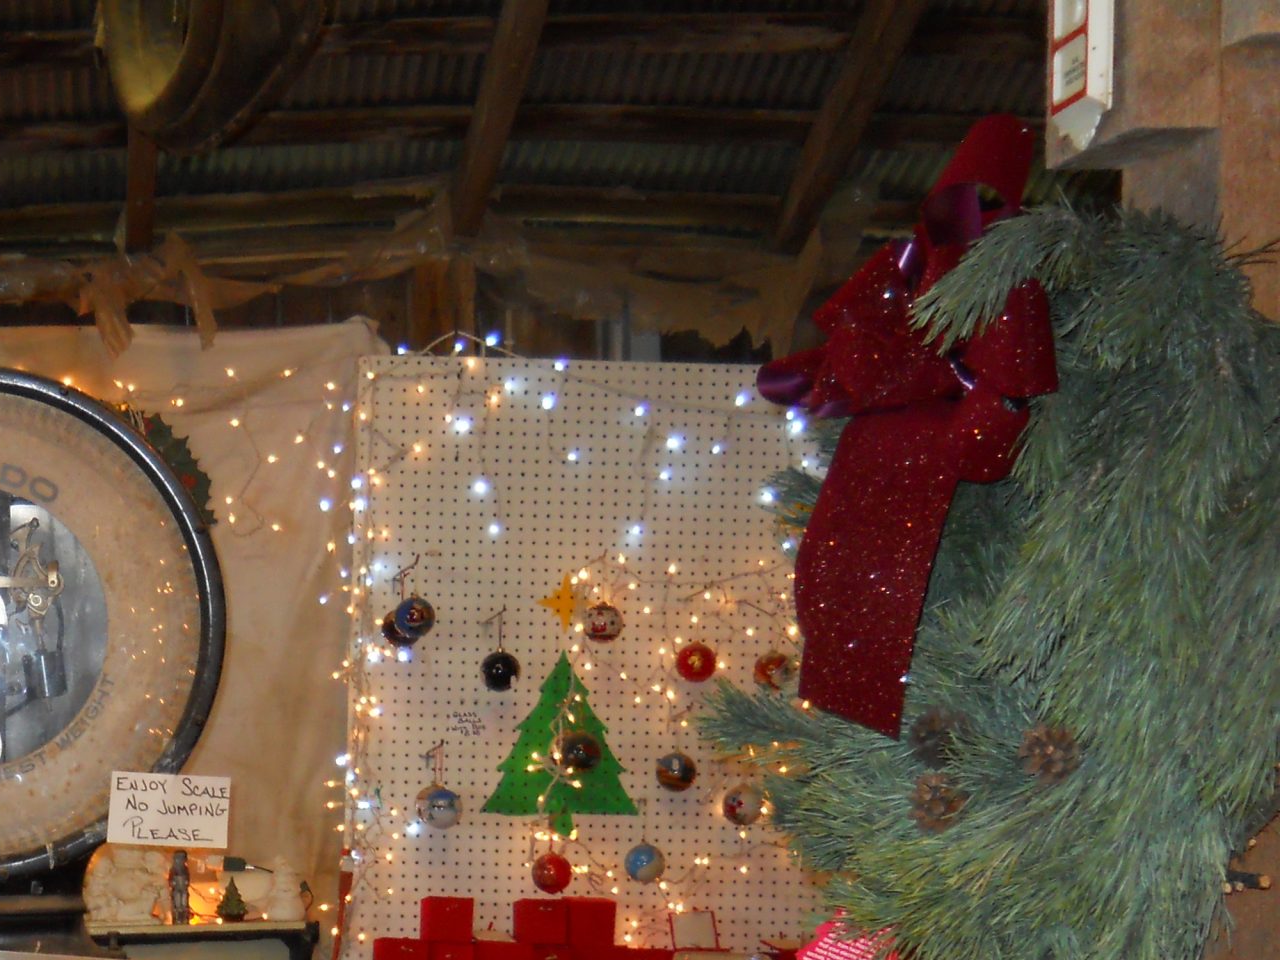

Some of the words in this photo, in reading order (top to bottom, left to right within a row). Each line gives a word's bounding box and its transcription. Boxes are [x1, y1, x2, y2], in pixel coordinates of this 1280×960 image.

[55, 671, 115, 749] WEIGHT
[116, 776, 167, 794] ENJOY
[181, 777, 230, 799] SCALE
[125, 794, 149, 812] NO
[157, 799, 227, 817] JUMPING
[123, 816, 213, 841] PLEASE
